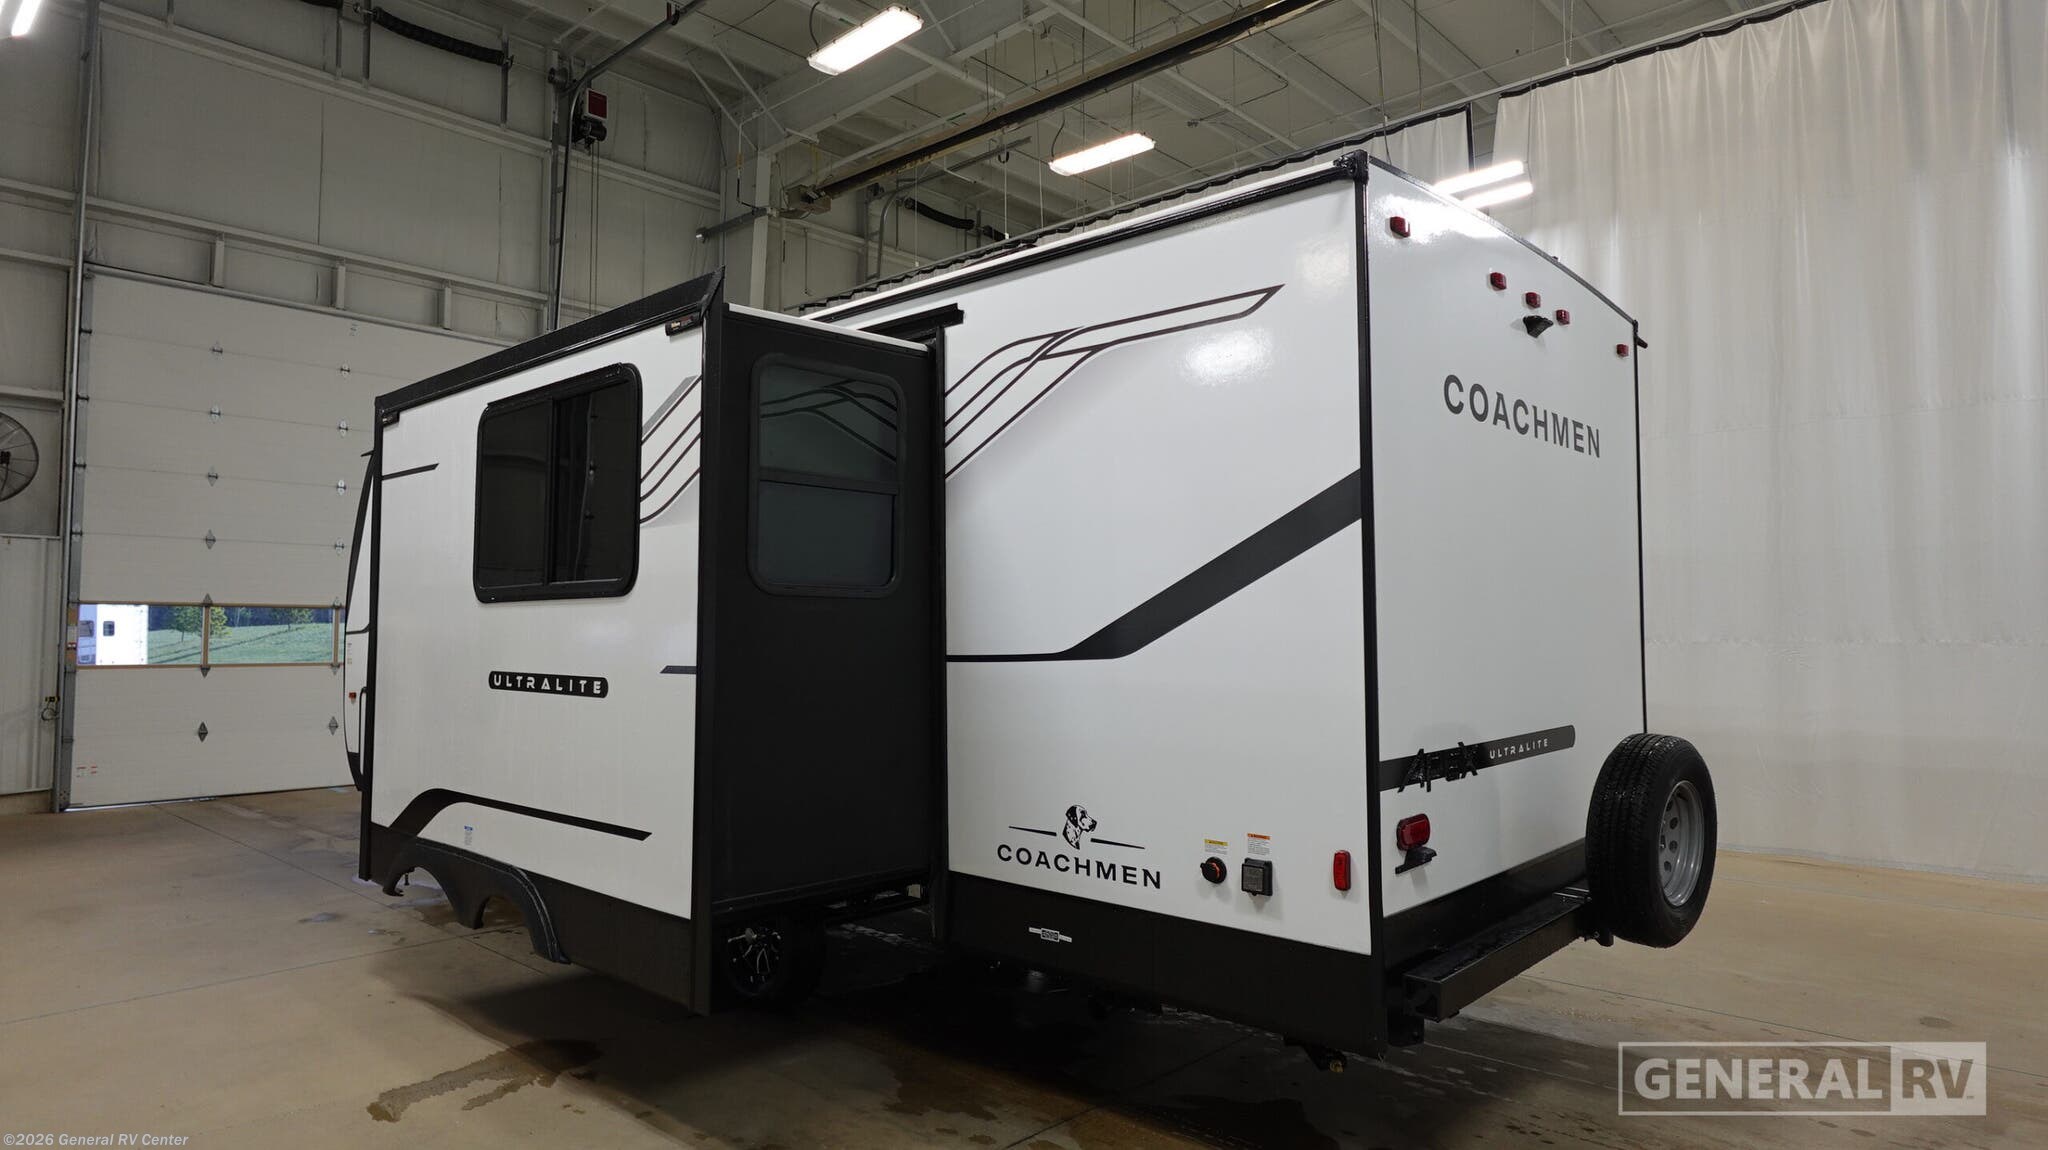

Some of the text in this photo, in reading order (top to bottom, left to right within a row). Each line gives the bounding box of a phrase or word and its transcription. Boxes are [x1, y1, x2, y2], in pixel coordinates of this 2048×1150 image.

[1444, 374, 1600, 458] COACHMEN
[493, 674, 602, 694] ULTRALITE
[1489, 738, 1549, 759] ULTRALITE
[997, 844, 1161, 889] COACHMEN
